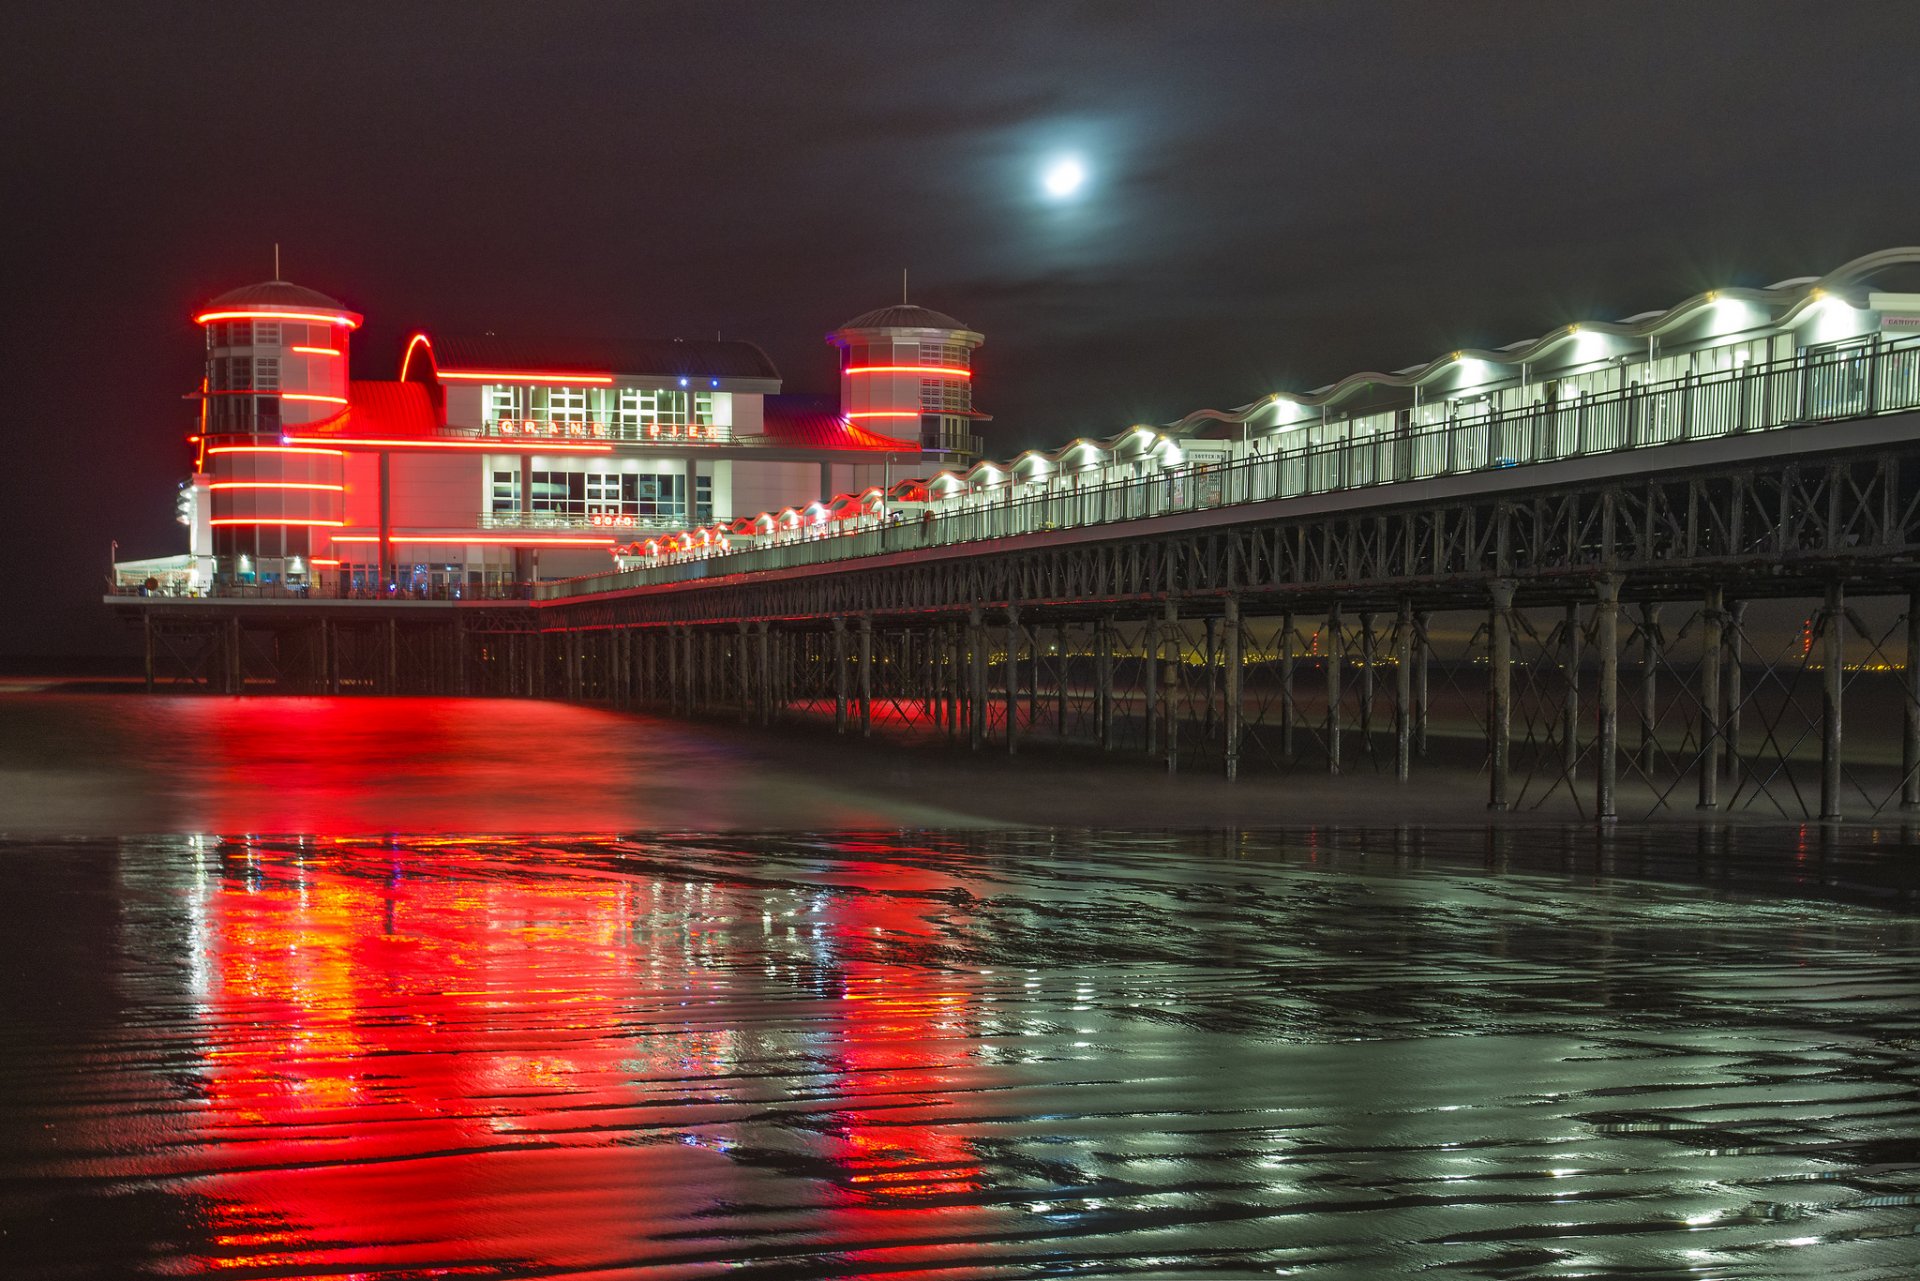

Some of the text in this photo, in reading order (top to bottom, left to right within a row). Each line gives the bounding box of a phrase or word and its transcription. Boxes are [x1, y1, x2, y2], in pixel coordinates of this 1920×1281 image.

[501, 420, 719, 438] GRAND PIER
[593, 515, 633, 526] 2010
